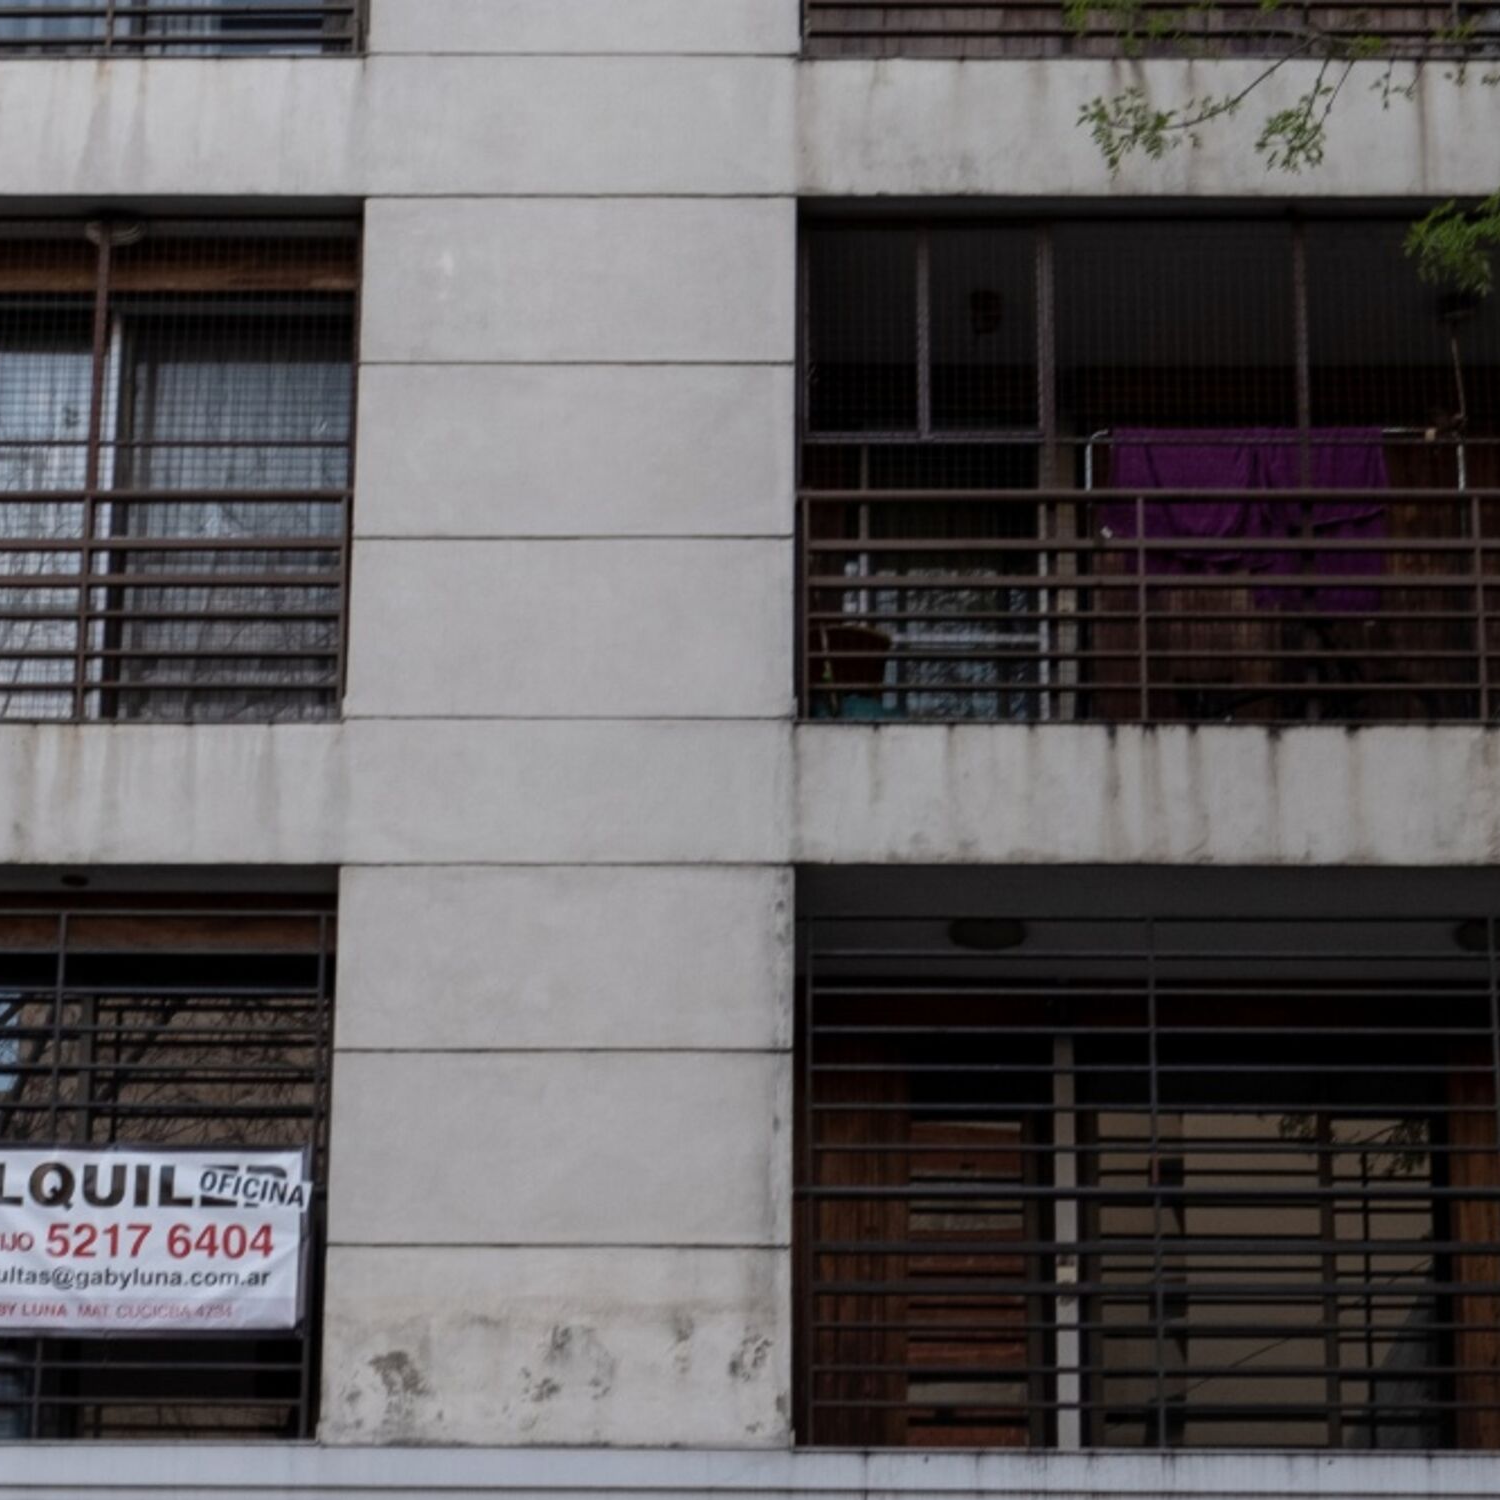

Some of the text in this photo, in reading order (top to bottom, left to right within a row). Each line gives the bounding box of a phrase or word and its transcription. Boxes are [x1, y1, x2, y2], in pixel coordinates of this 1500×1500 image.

[200, 1168, 304, 1208] OFICINA
[46, 1222, 152, 1258] 5217
[167, 1222, 275, 1259] 6404
[22, 1302, 67, 1318] LUNA
